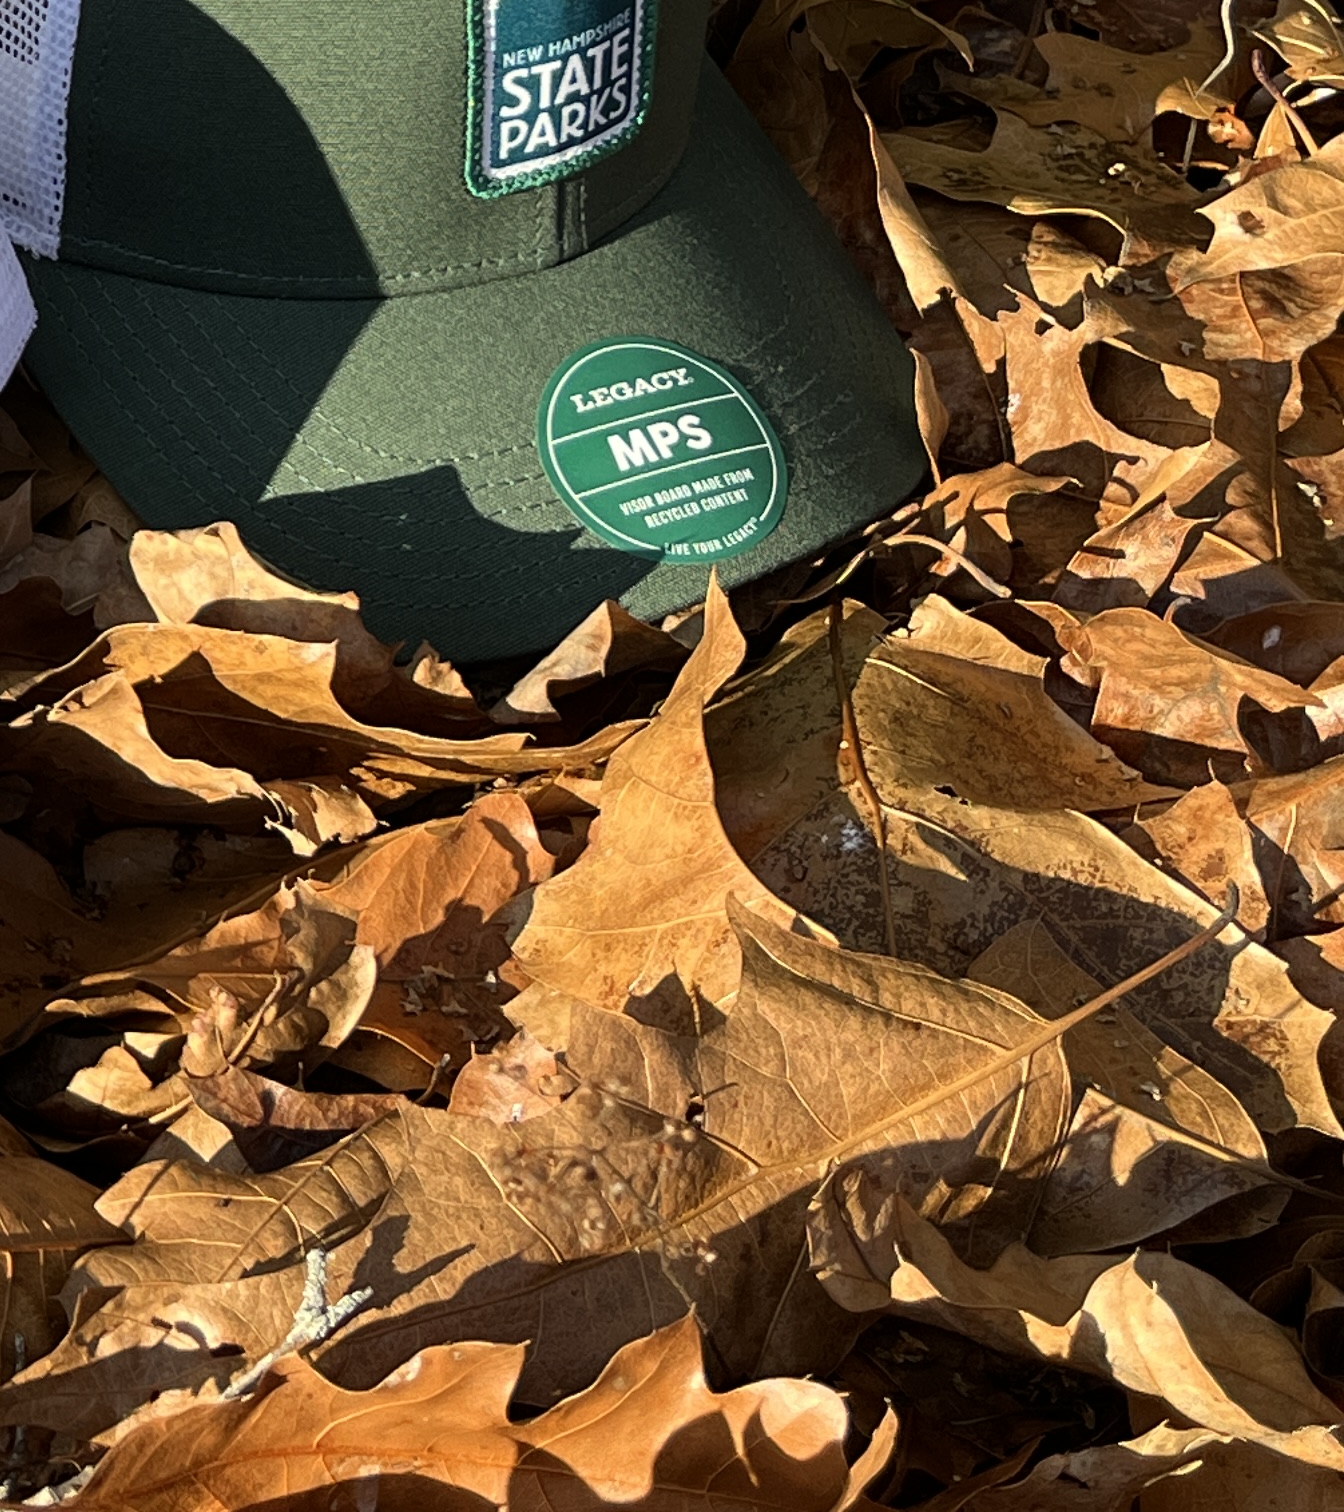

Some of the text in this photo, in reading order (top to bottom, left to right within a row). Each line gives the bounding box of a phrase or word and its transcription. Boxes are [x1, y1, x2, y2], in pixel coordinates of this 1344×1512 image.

[502, 7, 631, 69] NEW HAMPSHIRE
[500, 28, 631, 118] STATE
[499, 77, 629, 161] PARKS
[607, 414, 713, 472] MPS
[619, 468, 755, 516] VISOR BOARD MADE FROM
[644, 488, 749, 529] RECYCLED CONTENT
[664, 542, 691, 555] LIVE
[692, 539, 722, 555] YOUR
